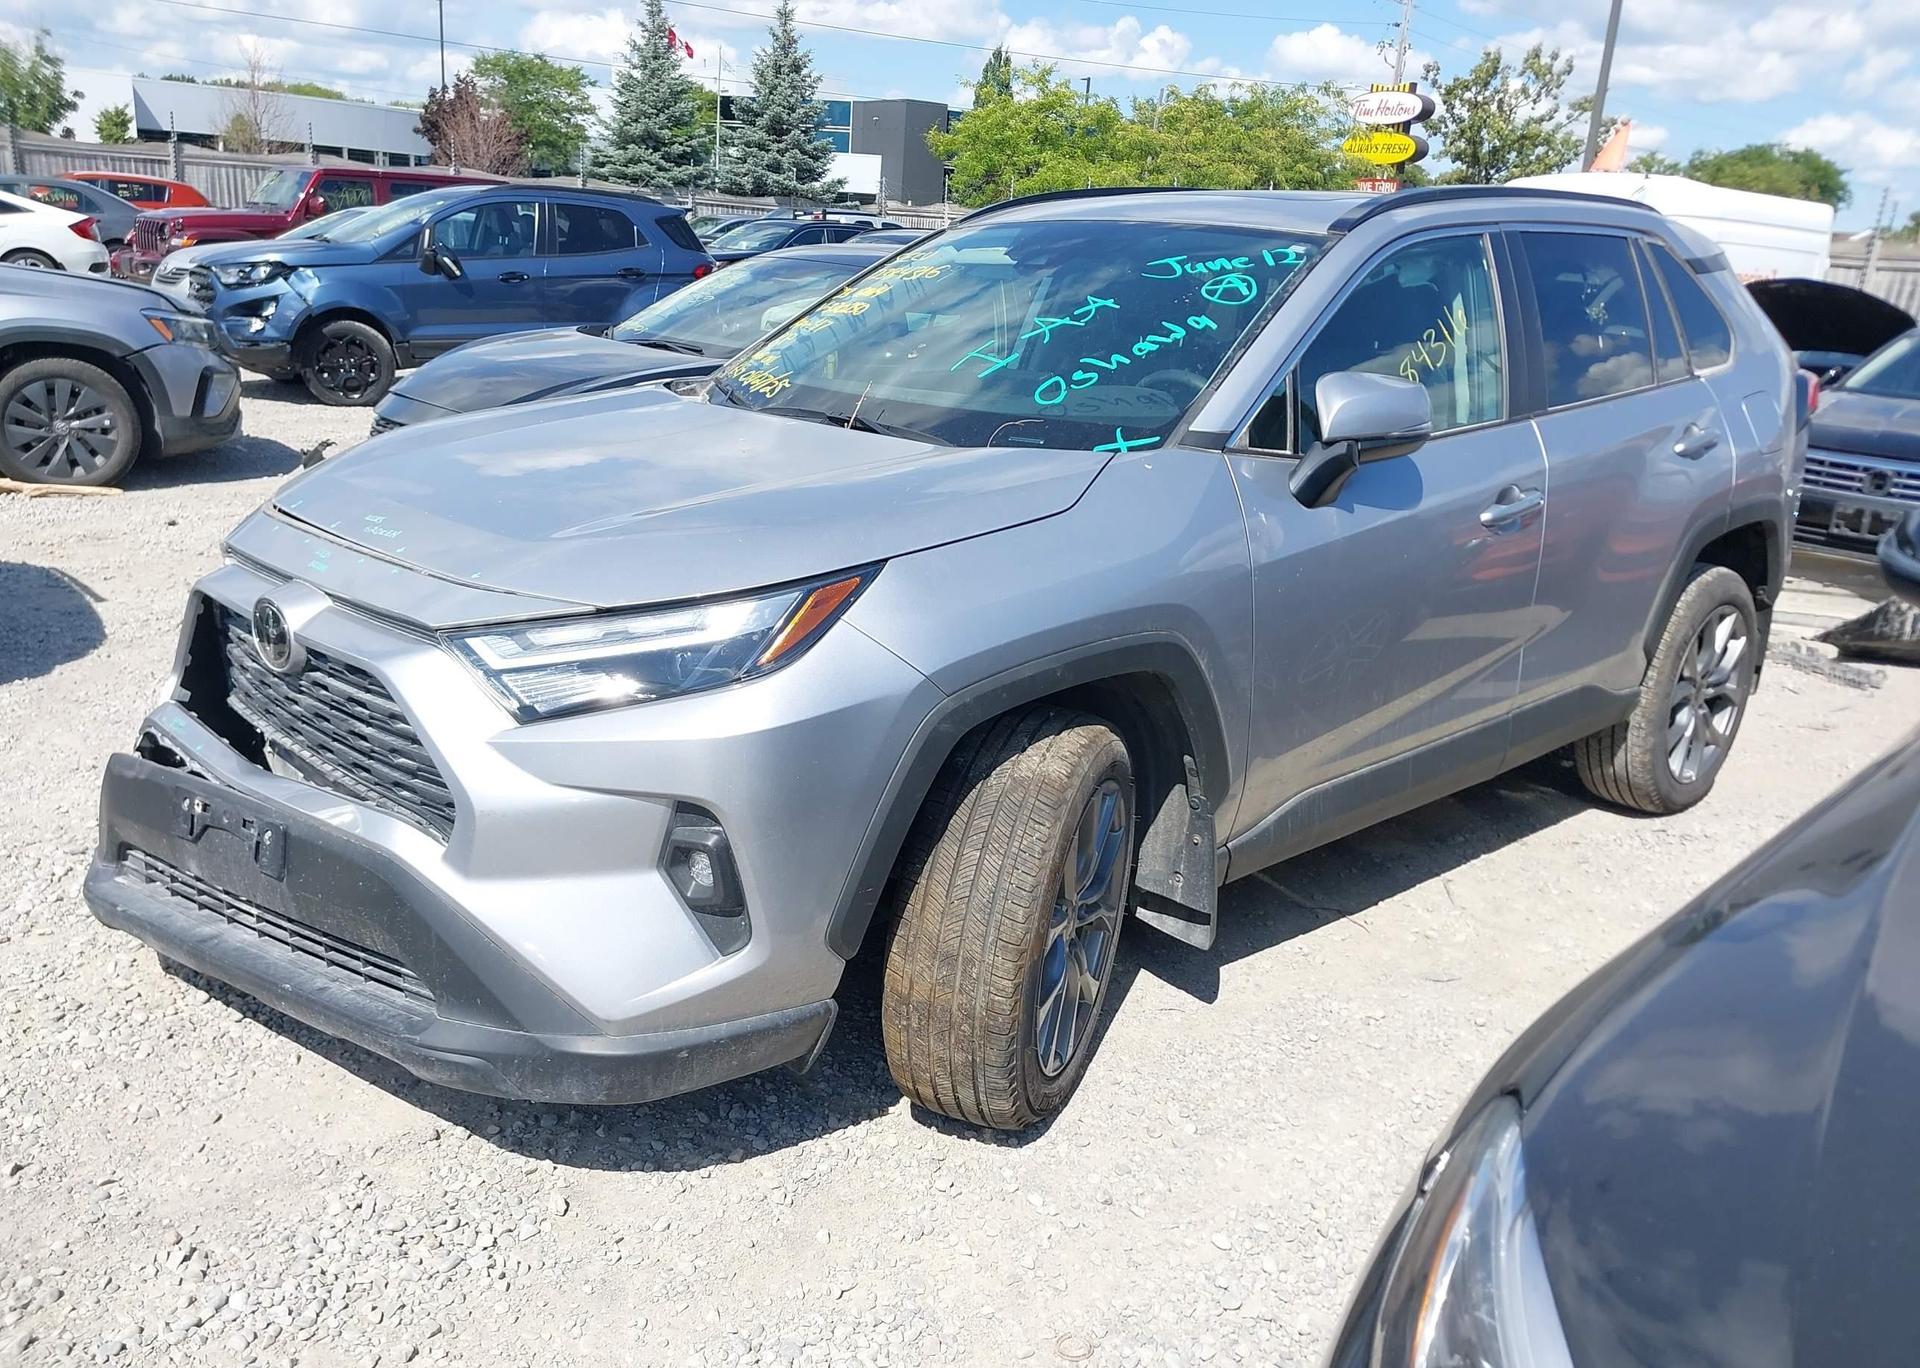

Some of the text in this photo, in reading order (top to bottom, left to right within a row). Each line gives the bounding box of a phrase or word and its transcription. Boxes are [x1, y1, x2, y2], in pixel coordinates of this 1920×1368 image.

[1354, 98, 1416, 117] Tim Hortons
[1345, 143, 1411, 154] ALWAYS FRESH
[1142, 256, 1254, 278] June
[1400, 305, 1470, 384] 84316
